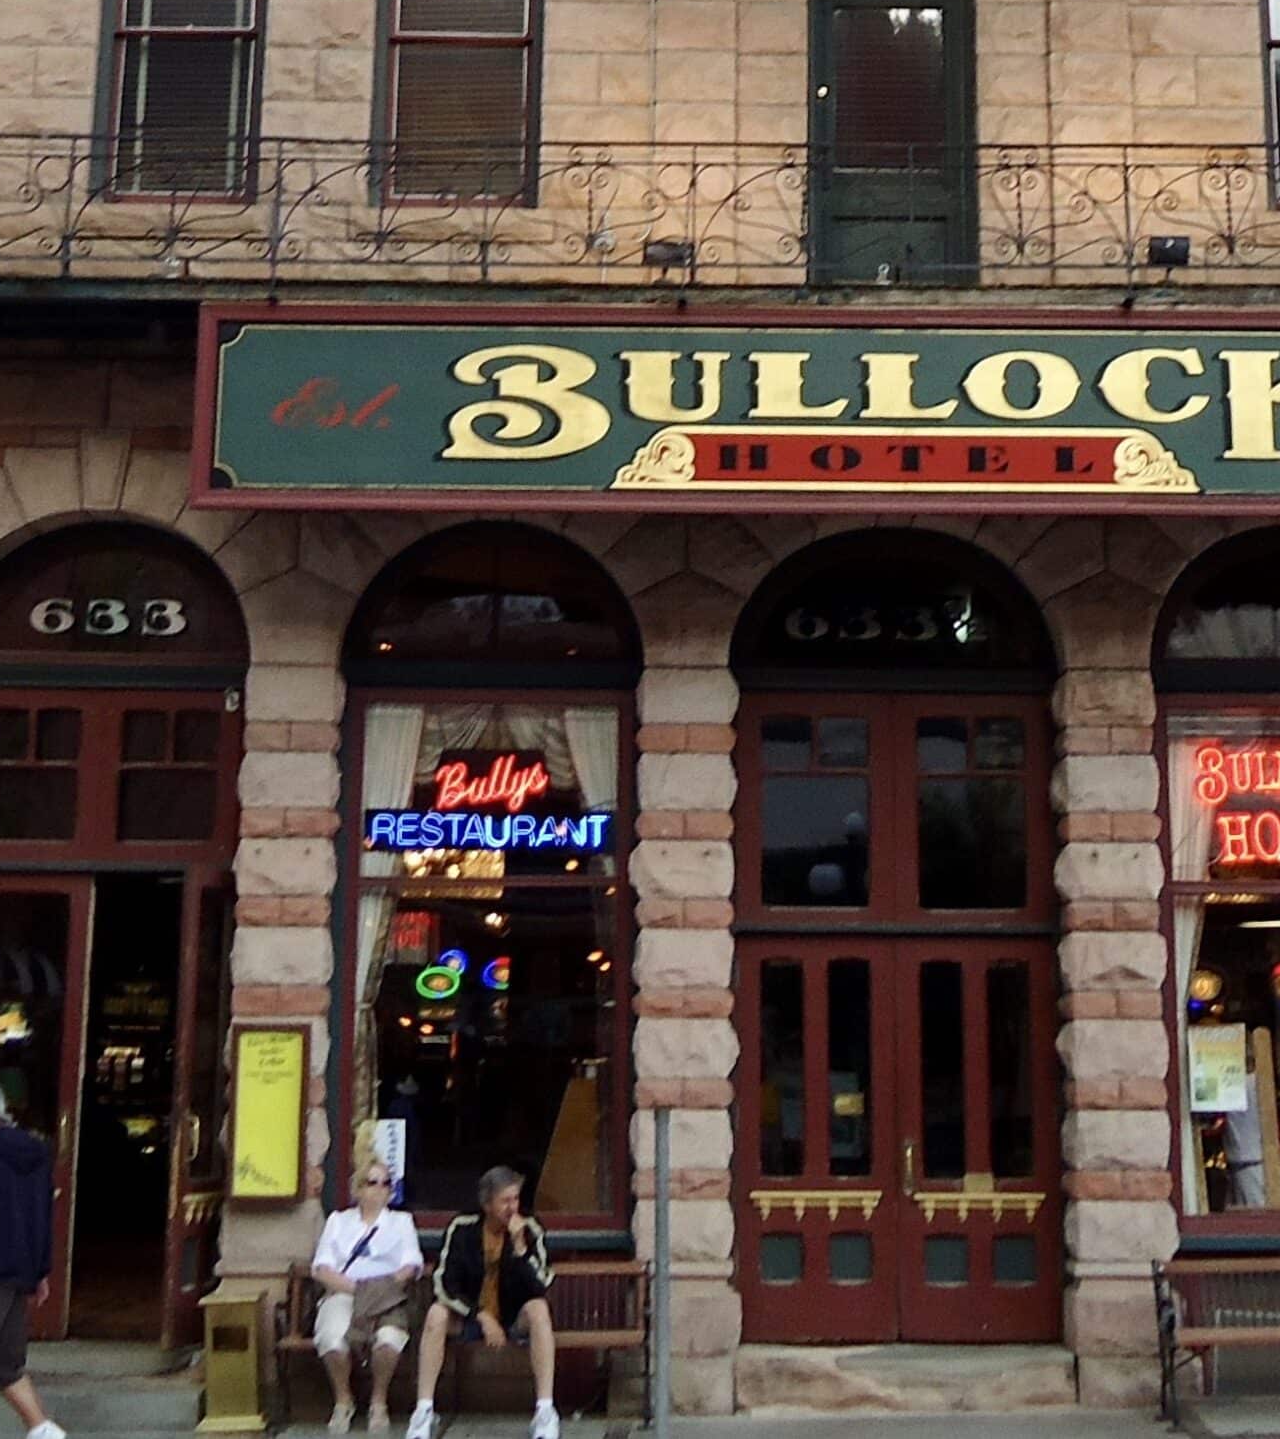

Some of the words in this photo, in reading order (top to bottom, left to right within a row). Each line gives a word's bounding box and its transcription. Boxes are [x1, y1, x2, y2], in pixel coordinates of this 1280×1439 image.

[720, 444, 1094, 473] HOTEL
[29, 597, 188, 636] 633
[371, 812, 611, 848] RESTAURANT
